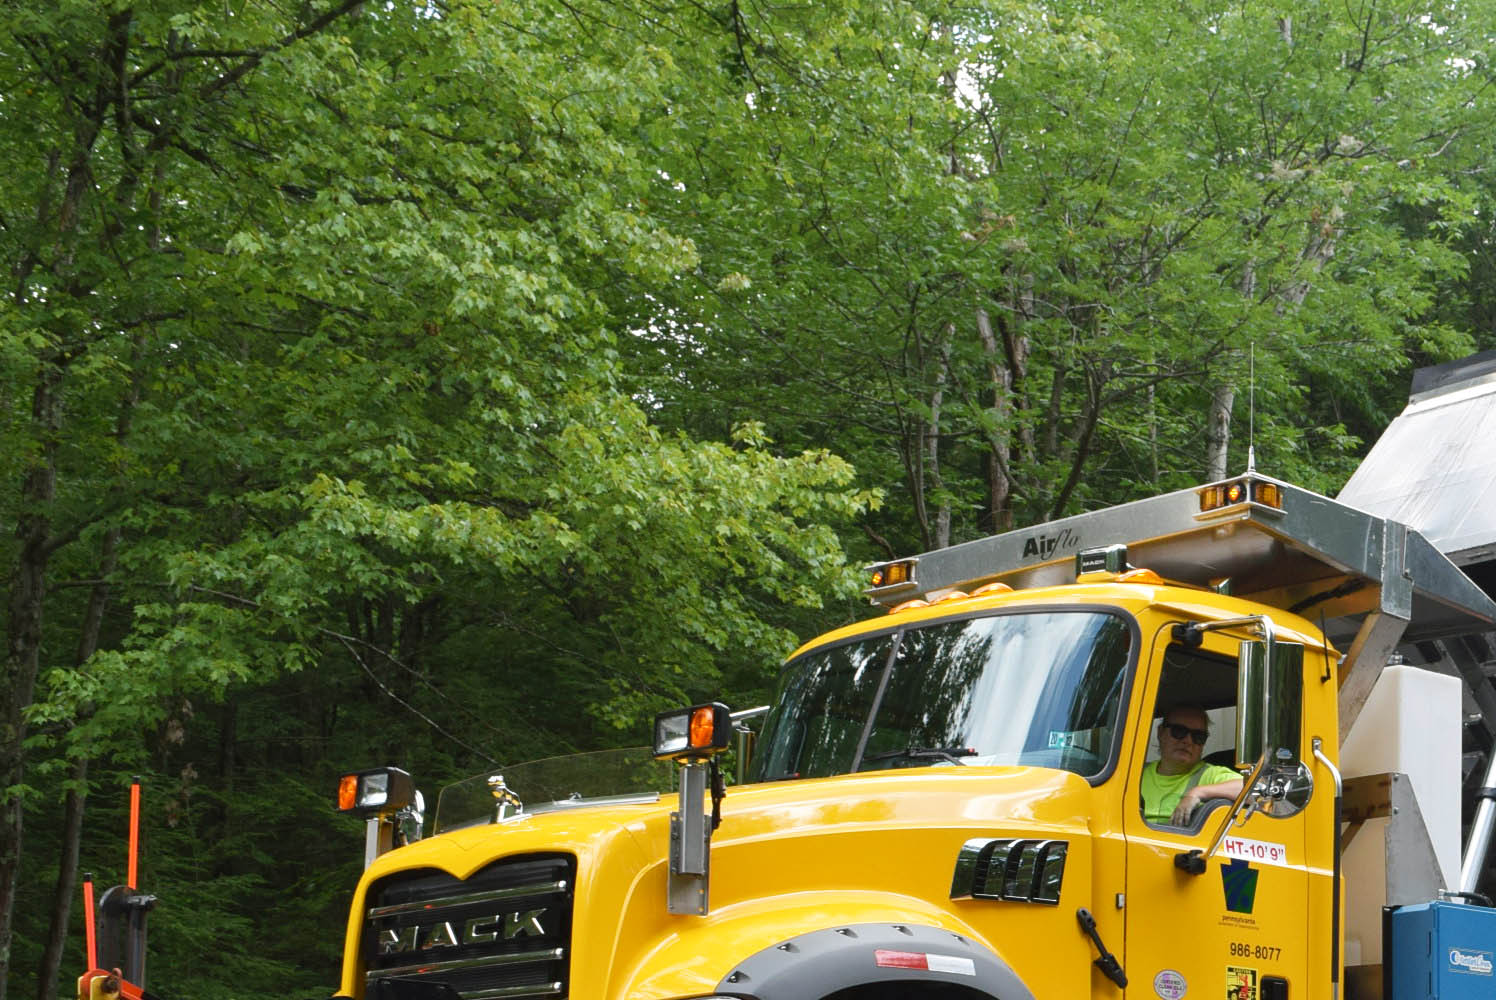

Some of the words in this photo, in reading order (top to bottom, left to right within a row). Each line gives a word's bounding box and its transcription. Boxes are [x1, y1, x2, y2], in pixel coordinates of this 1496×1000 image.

[1023, 528, 1080, 560] Airflo
[379, 908, 547, 954] MACK
[1230, 942, 1281, 961] 986-8077
